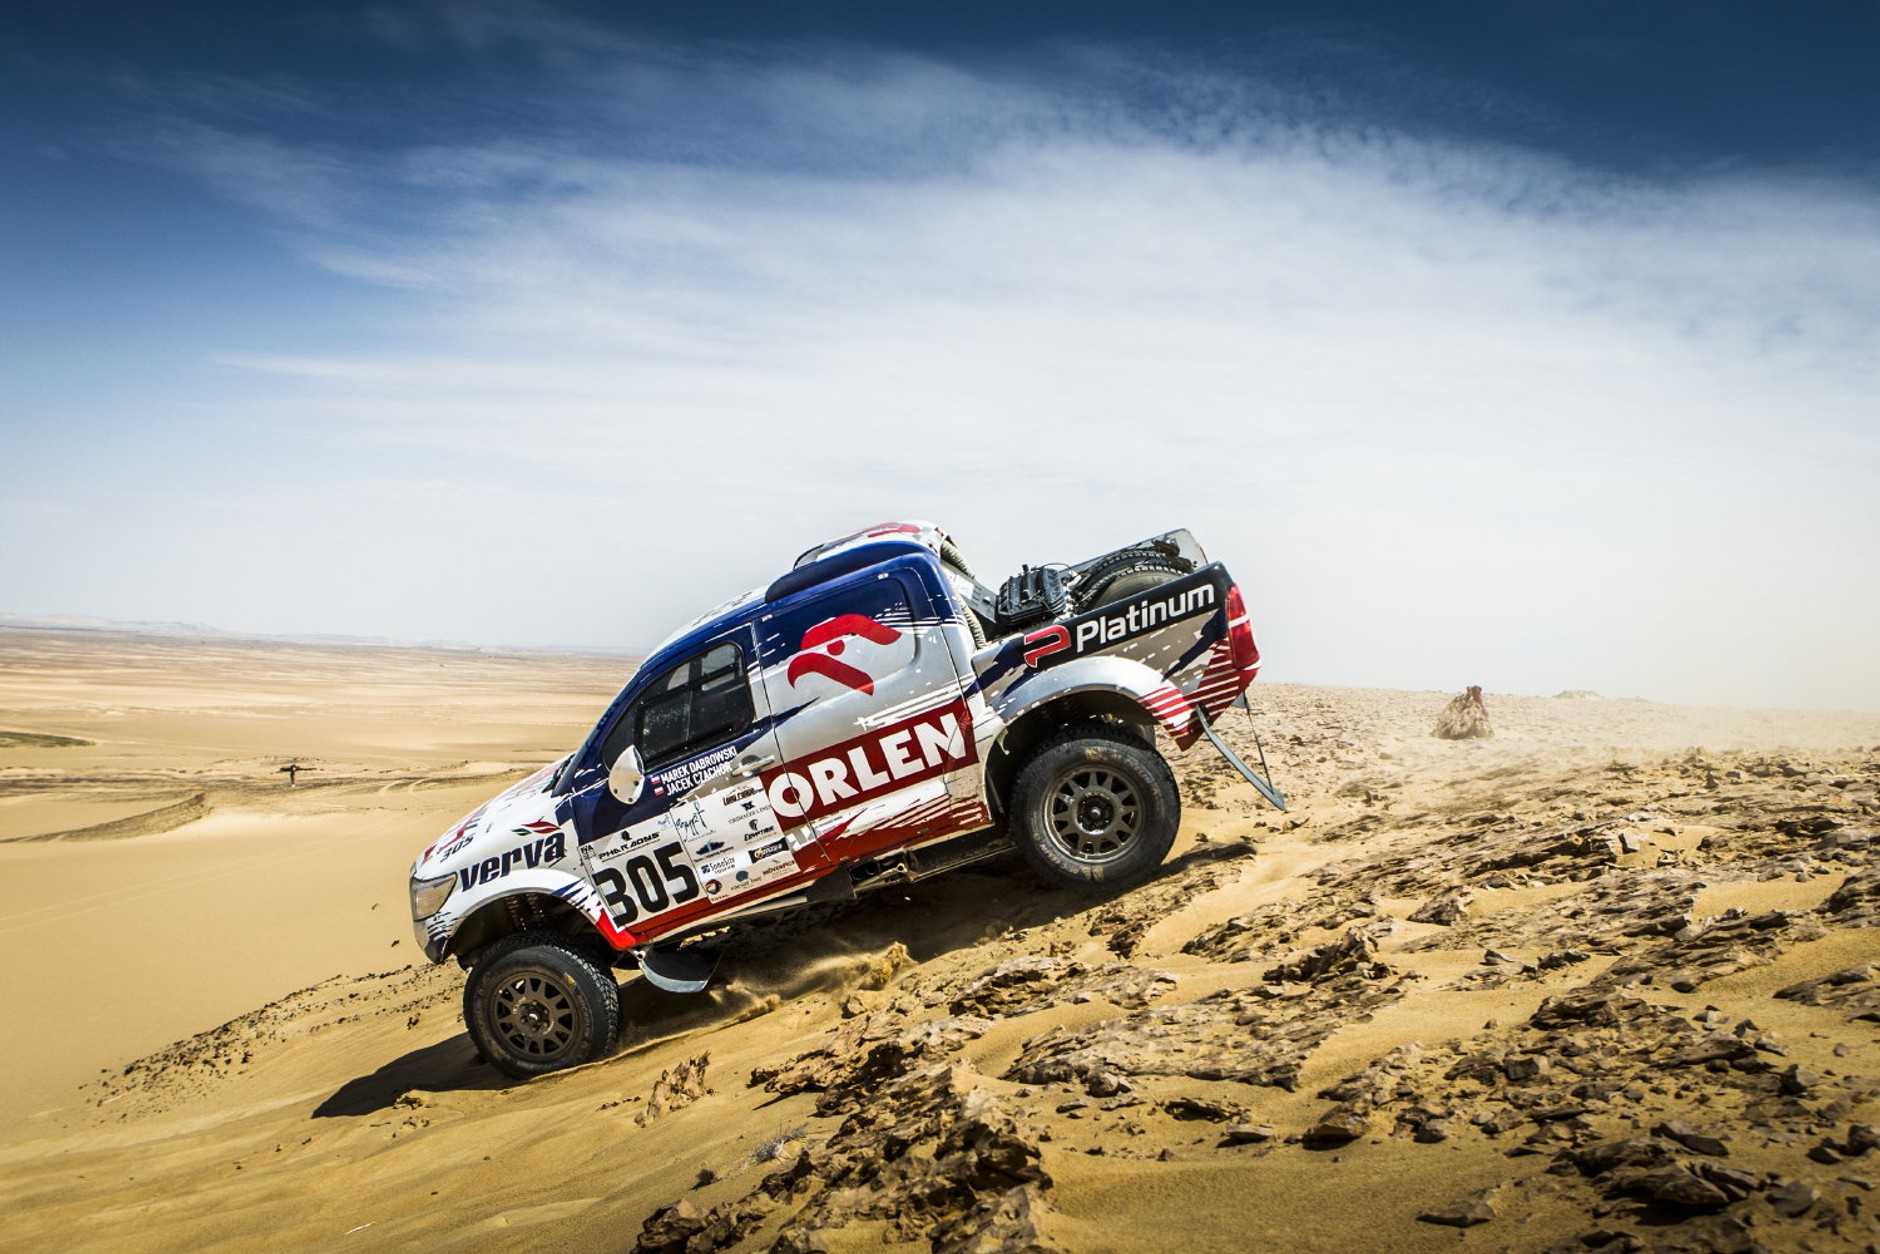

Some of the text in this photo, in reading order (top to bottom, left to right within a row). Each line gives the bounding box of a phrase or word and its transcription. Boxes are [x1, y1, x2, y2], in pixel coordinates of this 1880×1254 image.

[1076, 583, 1215, 653] Platinum
[660, 764, 690, 784] MAREK
[667, 777, 694, 796] JACEK
[768, 712, 967, 818] ORLEN
[440, 834, 474, 863] 305
[460, 832, 566, 893] verva
[592, 840, 701, 928] 305
